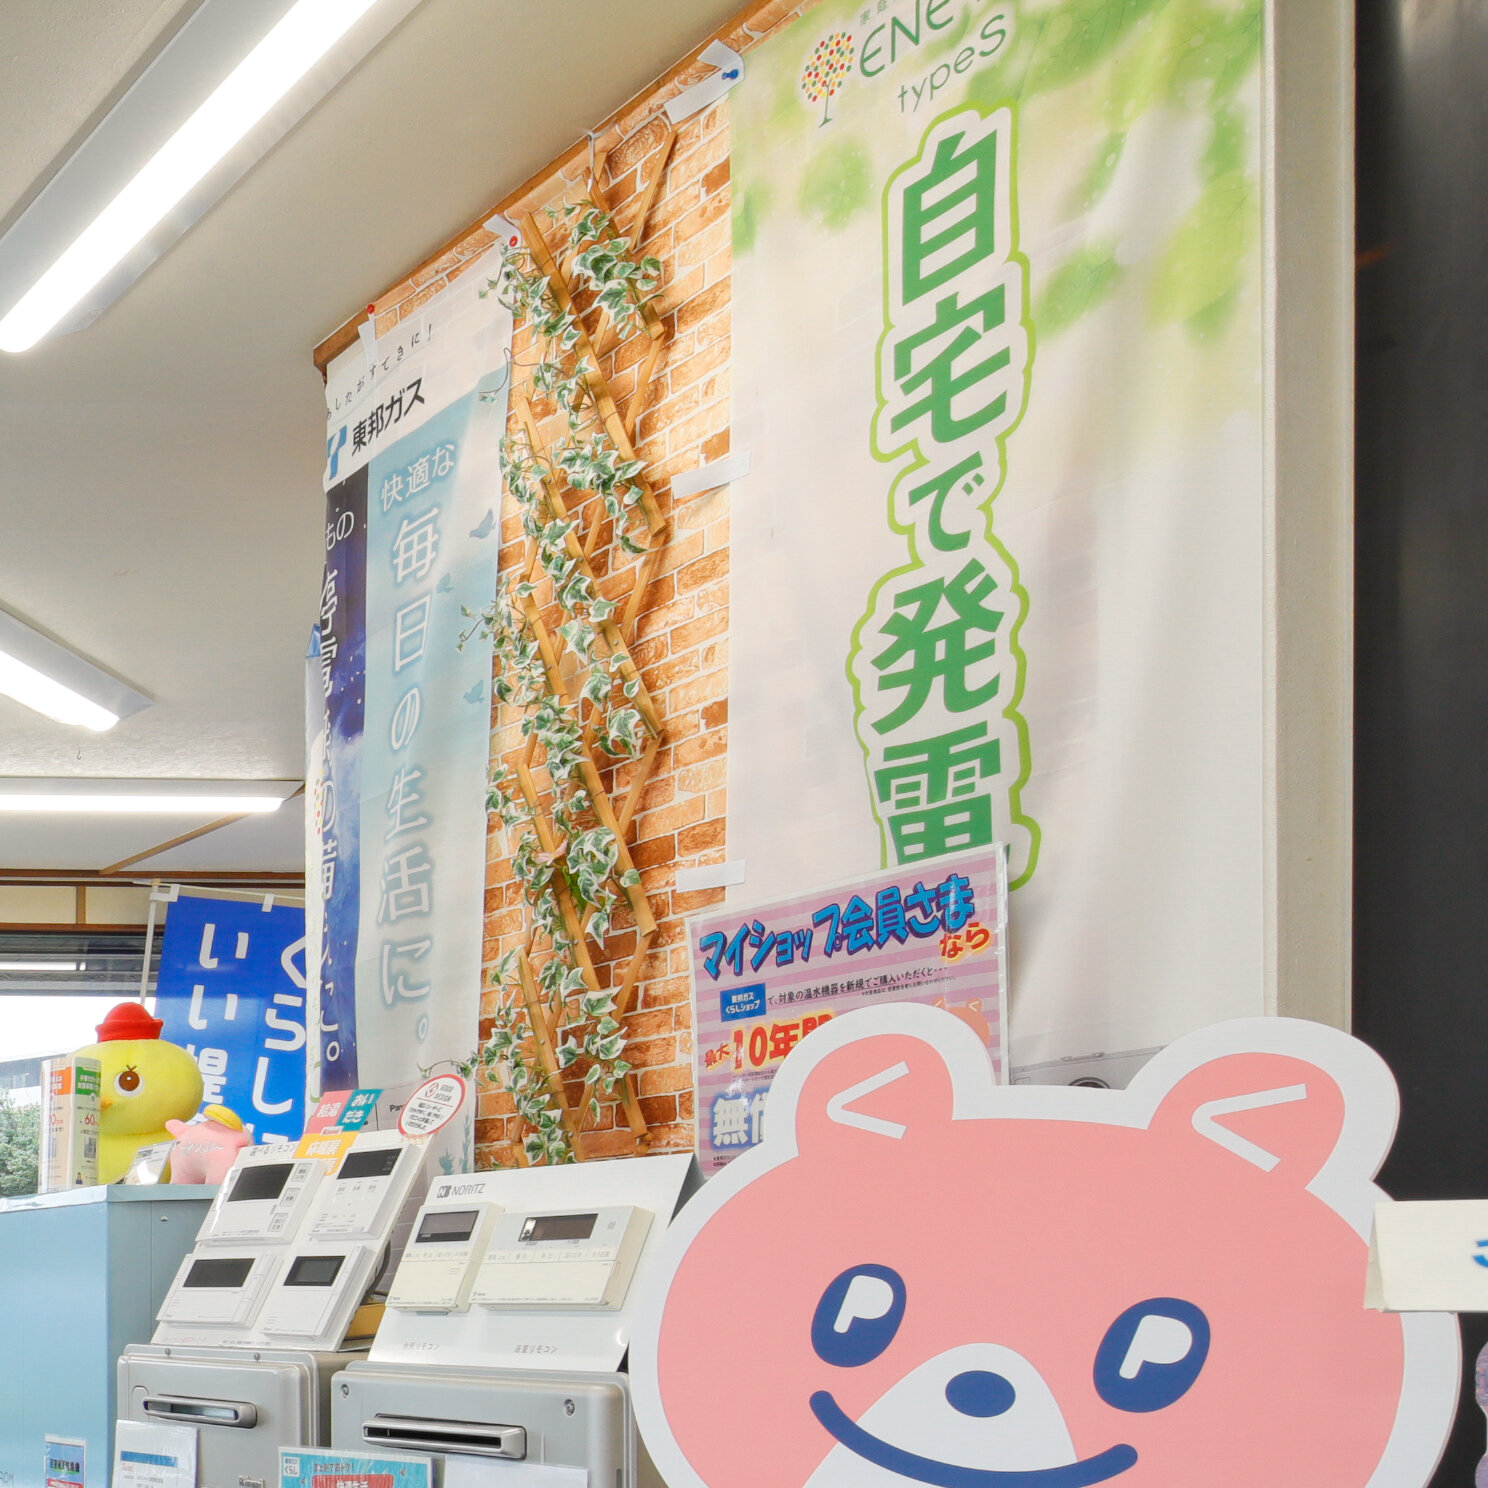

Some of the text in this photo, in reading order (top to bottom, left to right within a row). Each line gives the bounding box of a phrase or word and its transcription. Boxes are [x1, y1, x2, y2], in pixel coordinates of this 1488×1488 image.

[351, 377, 425, 456] 東邦ガス
[380, 443, 457, 512] 快適な
[377, 506, 443, 1041] 毎日の生活に。
[699, 873, 975, 981] マイショップ会員さま
[939, 921, 990, 961] なら
[451, 1183, 486, 1196] NORITZ
